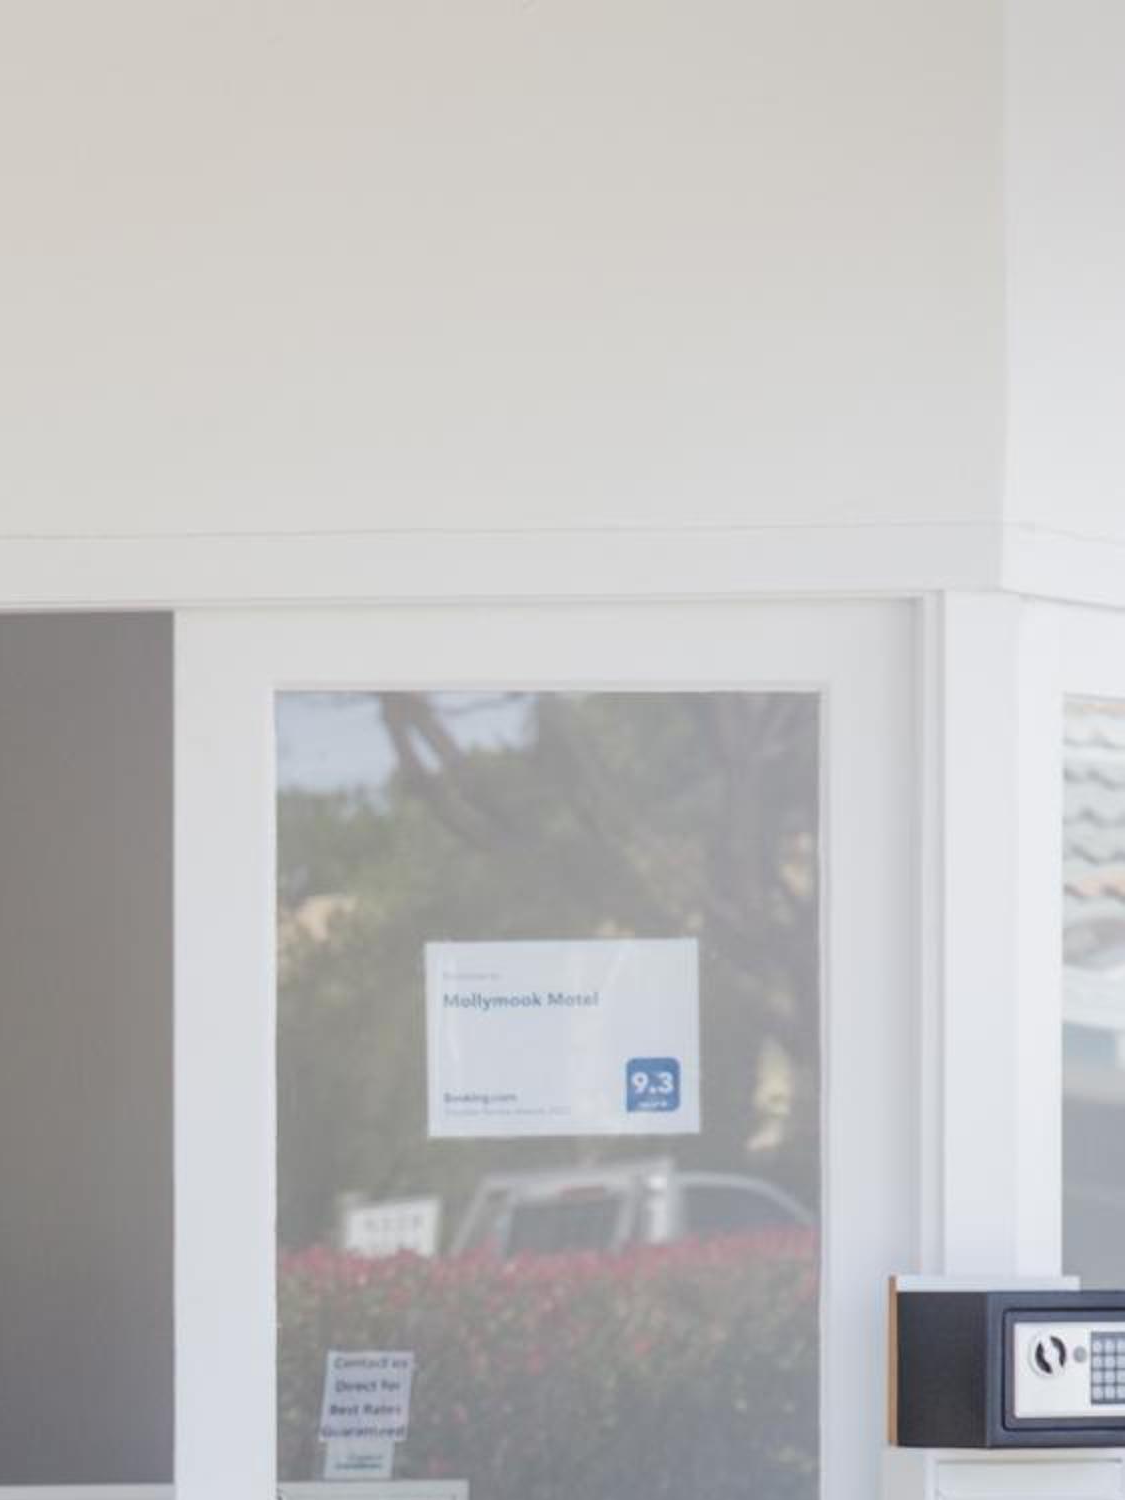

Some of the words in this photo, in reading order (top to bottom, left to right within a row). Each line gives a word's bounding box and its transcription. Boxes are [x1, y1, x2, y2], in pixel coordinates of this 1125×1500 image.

[442, 992, 542, 1011] Mollymook
[547, 991, 600, 1007] Motel
[630, 1071, 674, 1095] 9.3
[335, 1381, 377, 1393] Direct
[330, 1404, 359, 1416] Best
[363, 1404, 402, 1416] Rates
